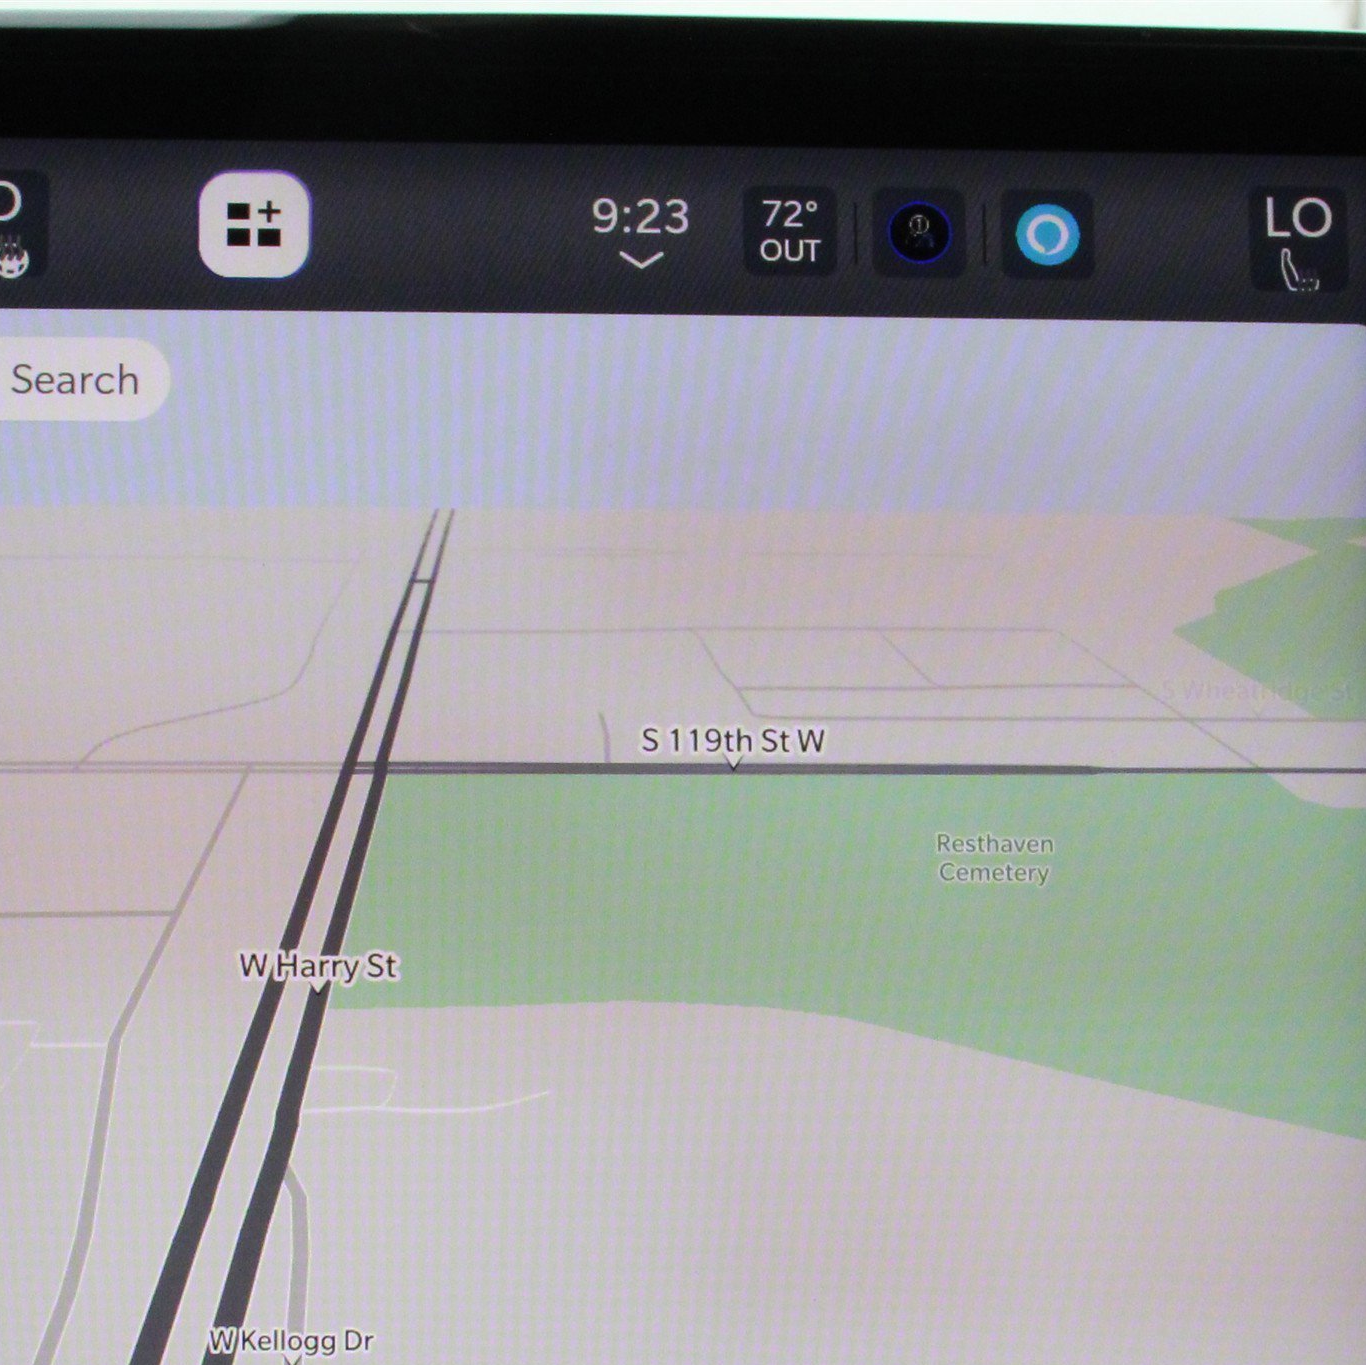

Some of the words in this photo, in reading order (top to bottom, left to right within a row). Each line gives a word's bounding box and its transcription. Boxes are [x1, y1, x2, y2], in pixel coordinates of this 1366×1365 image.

[592, 197, 689, 235] 9:23
[1266, 196, 1333, 238] LO
[759, 238, 822, 262] OUT
[11, 362, 139, 395] Search
[642, 727, 659, 752] S
[671, 728, 753, 753] 119th
[761, 728, 789, 753] St
[797, 729, 825, 753] W
[937, 834, 1054, 853] Resthaven
[939, 862, 1049, 886] Cemetery
[240, 953, 268, 978] W
[277, 953, 360, 984] Harry
[366, 953, 398, 979] St
[209, 1329, 235, 1352] W
[241, 1328, 337, 1359] Kellogg
[344, 1329, 375, 1352] Dr
